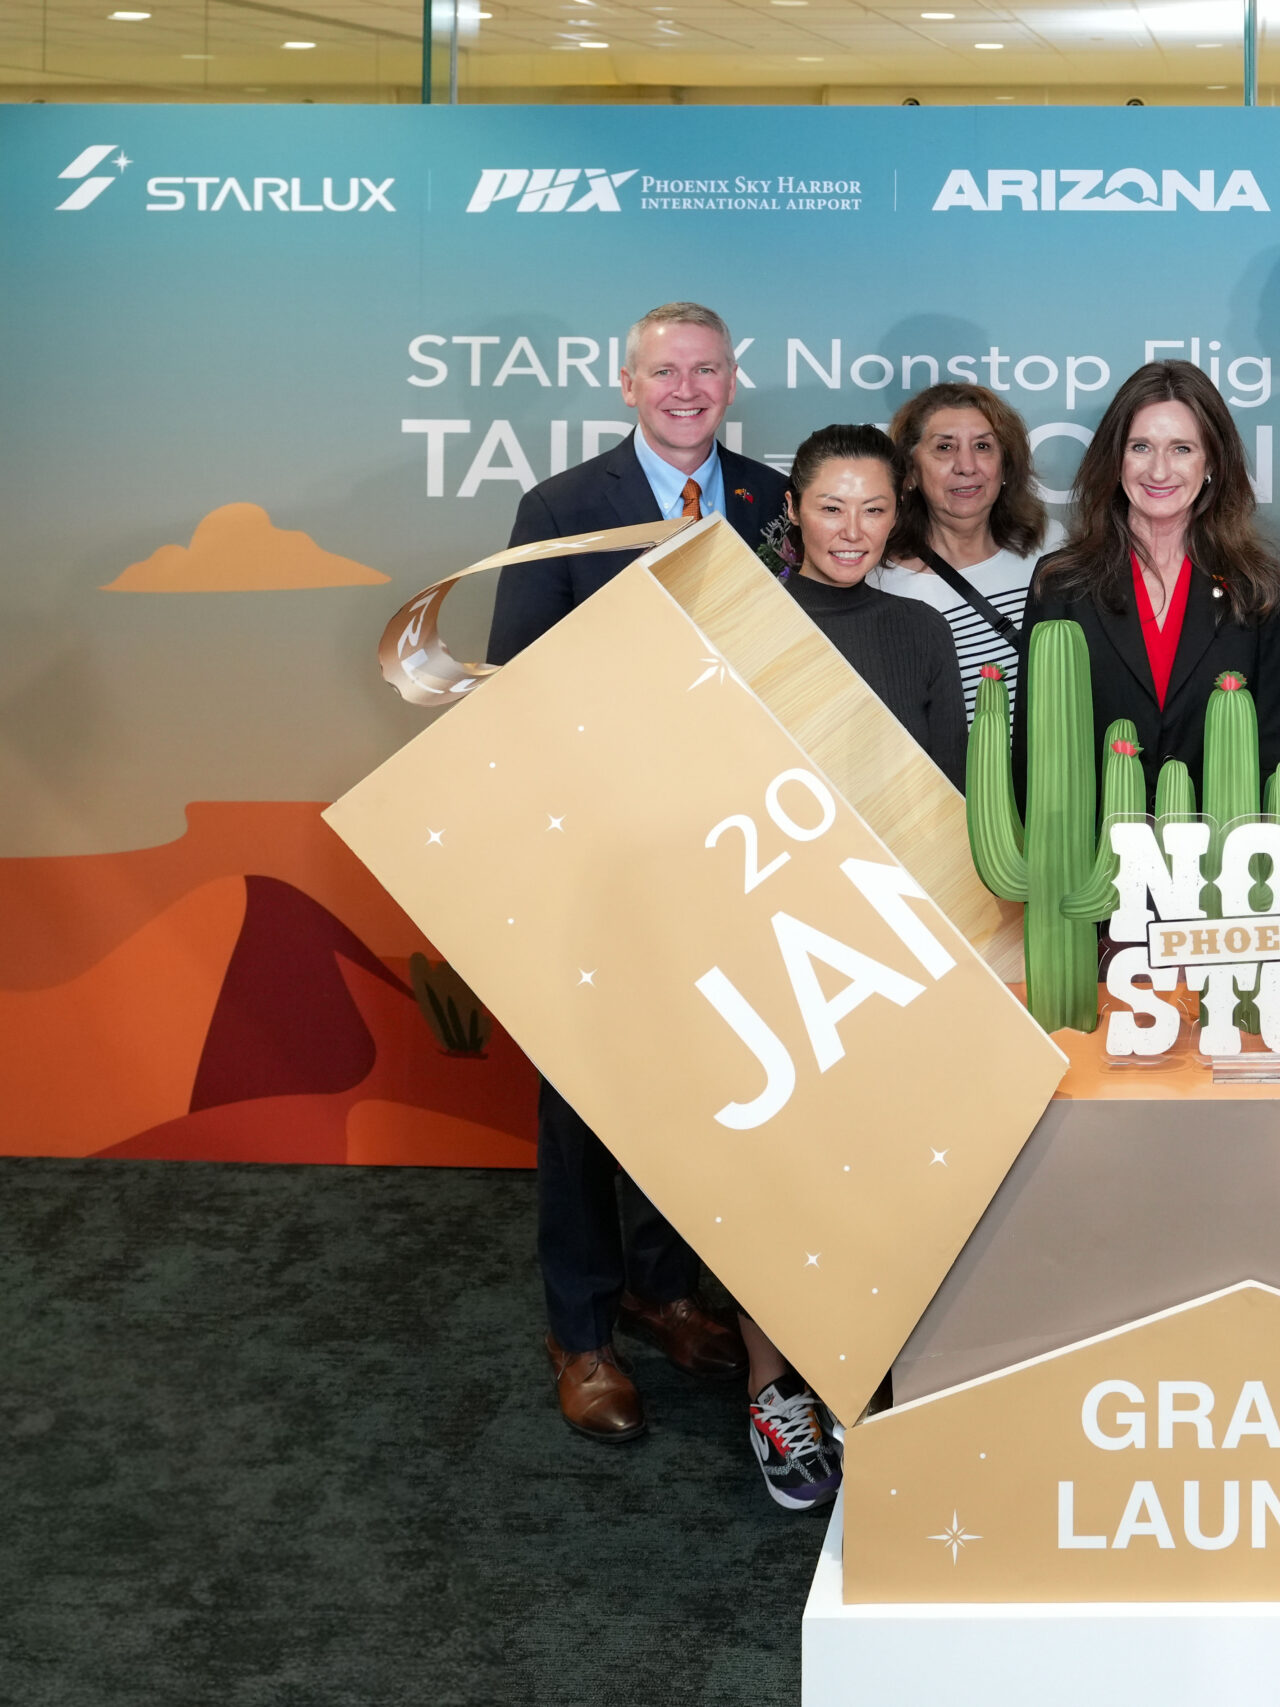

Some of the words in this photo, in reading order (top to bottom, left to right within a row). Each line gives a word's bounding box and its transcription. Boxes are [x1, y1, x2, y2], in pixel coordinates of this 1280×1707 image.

[146, 177, 396, 212] STARLUX
[465, 168, 640, 213] PHX
[641, 197, 780, 210] INTERNATIONAL
[786, 198, 862, 211] AIRPORT
[932, 168, 1271, 212] ARIZONA
[406, 334, 757, 389] STARL
[787, 338, 1110, 410] Nonstop
[704, 768, 836, 895] 20
